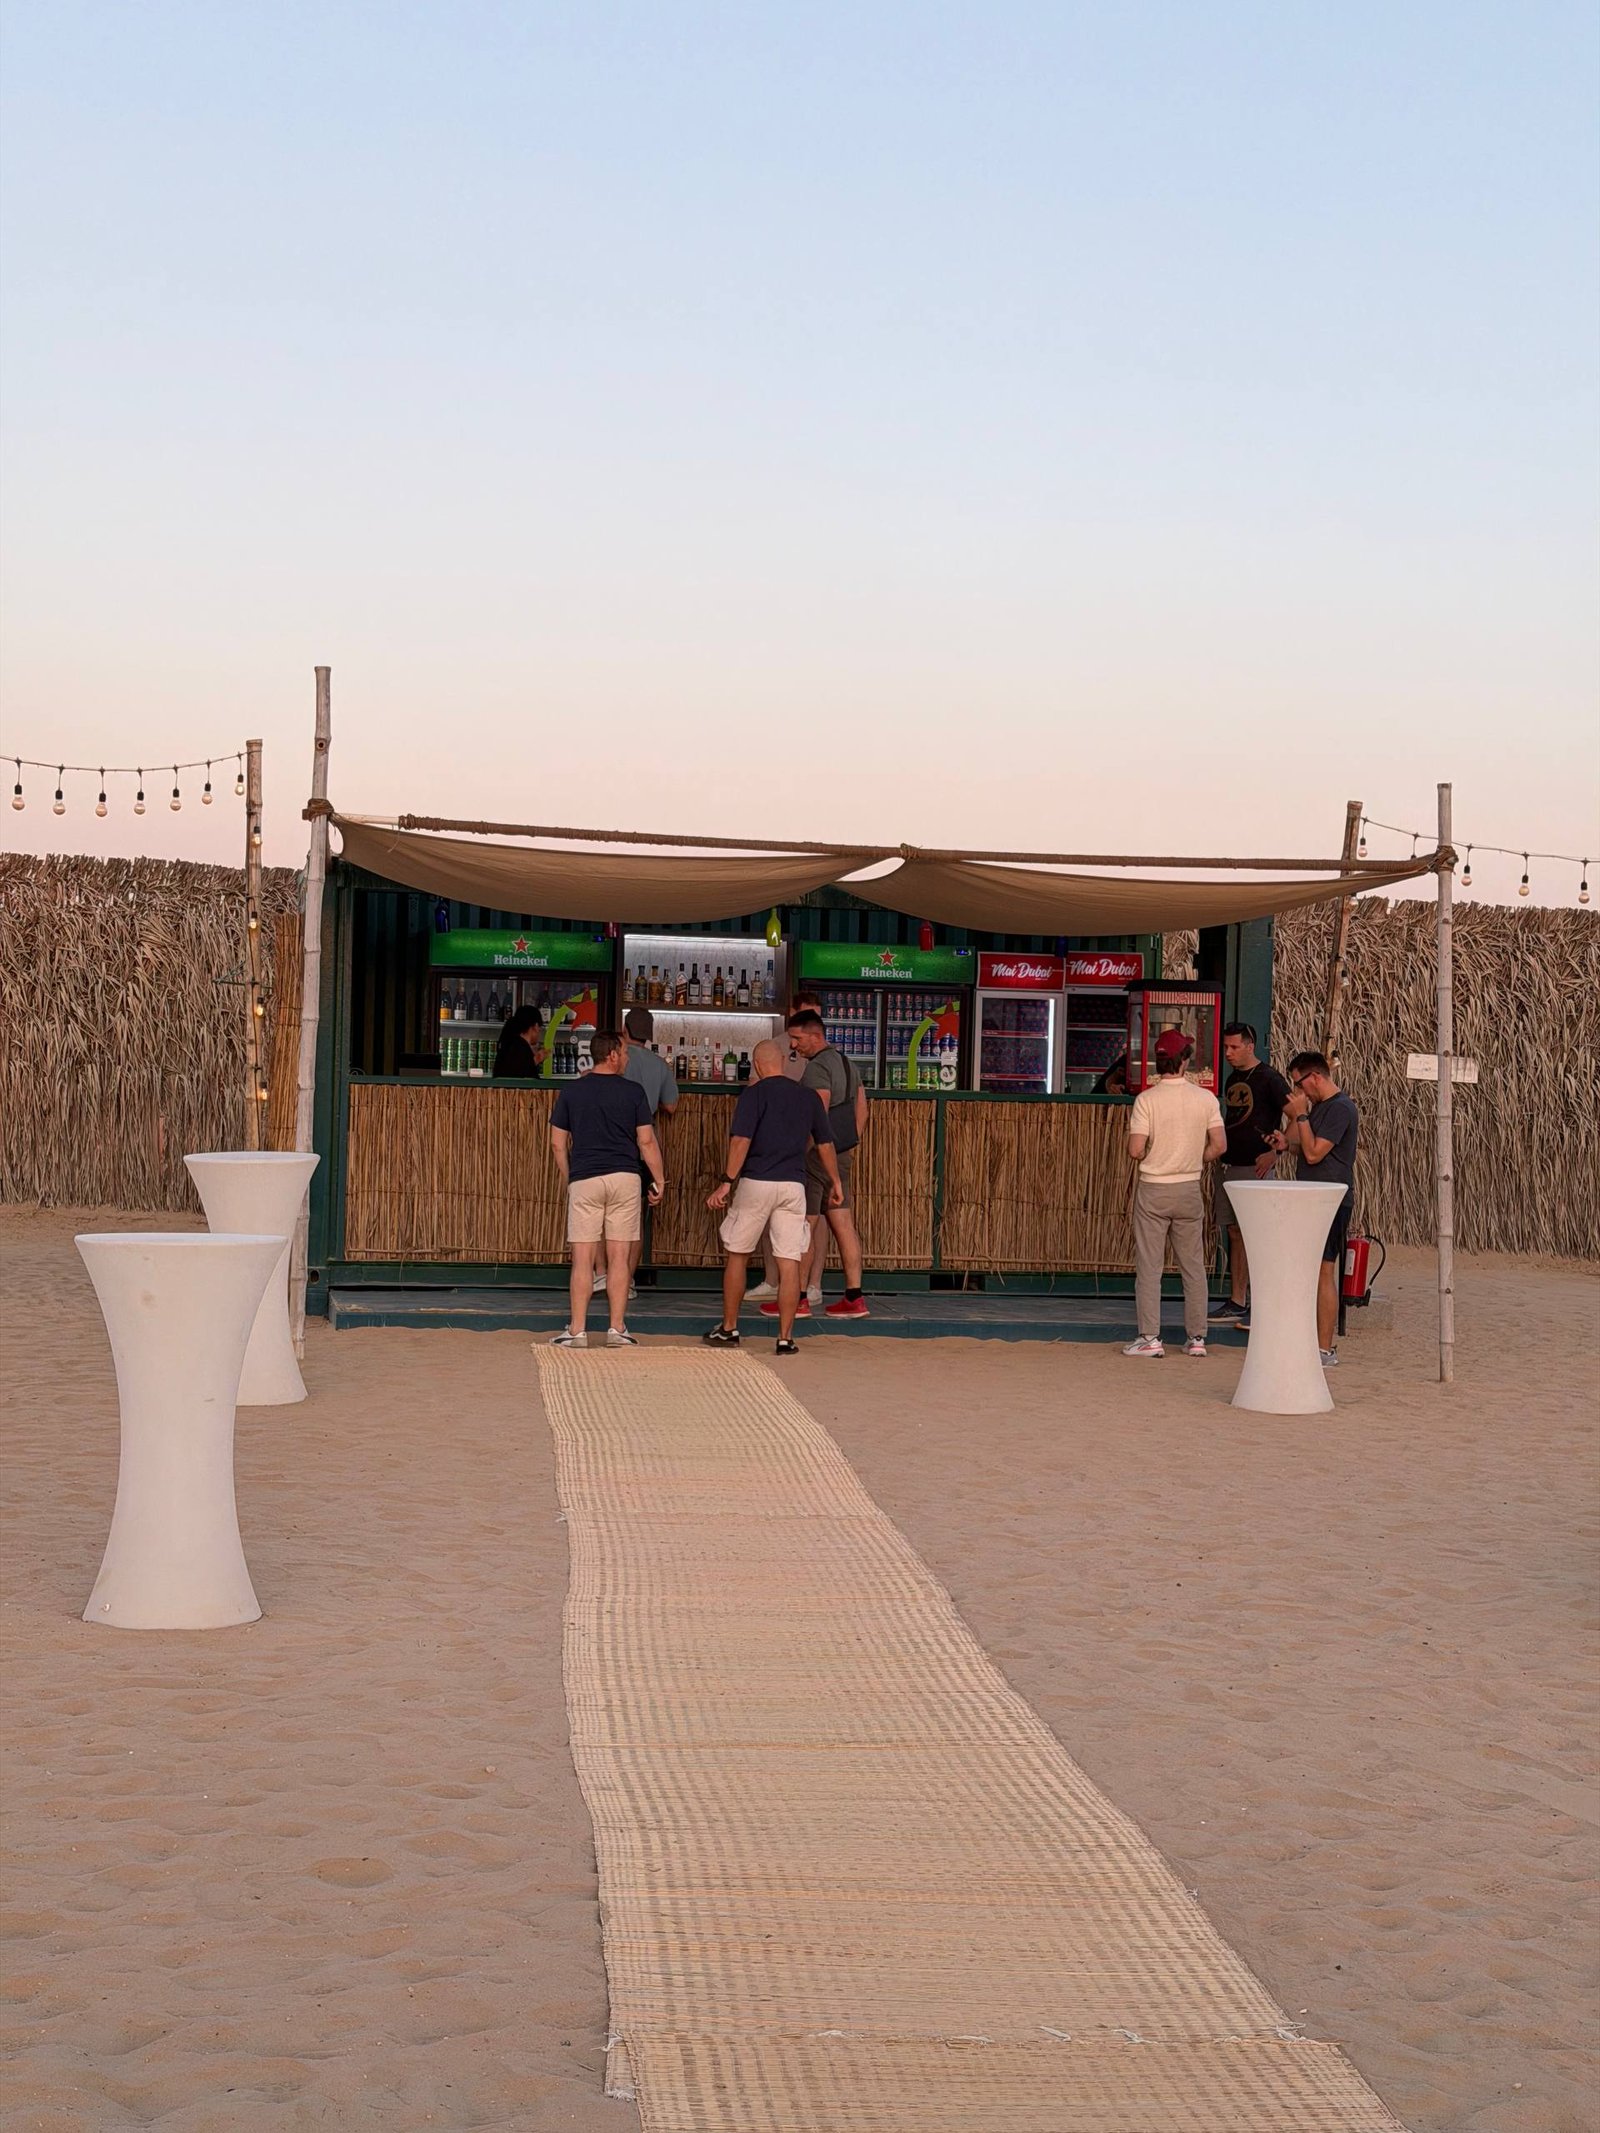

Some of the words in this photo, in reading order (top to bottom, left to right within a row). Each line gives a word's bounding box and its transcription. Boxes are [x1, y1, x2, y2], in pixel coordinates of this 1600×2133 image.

[494, 954, 548, 966] Heineken
[1070, 960, 1097, 977] Mai
[1098, 958, 1137, 977] Dubai
[861, 966, 913, 979] Heineken
[991, 963, 1017, 978] Mai
[1017, 962, 1053, 979] Dubai
